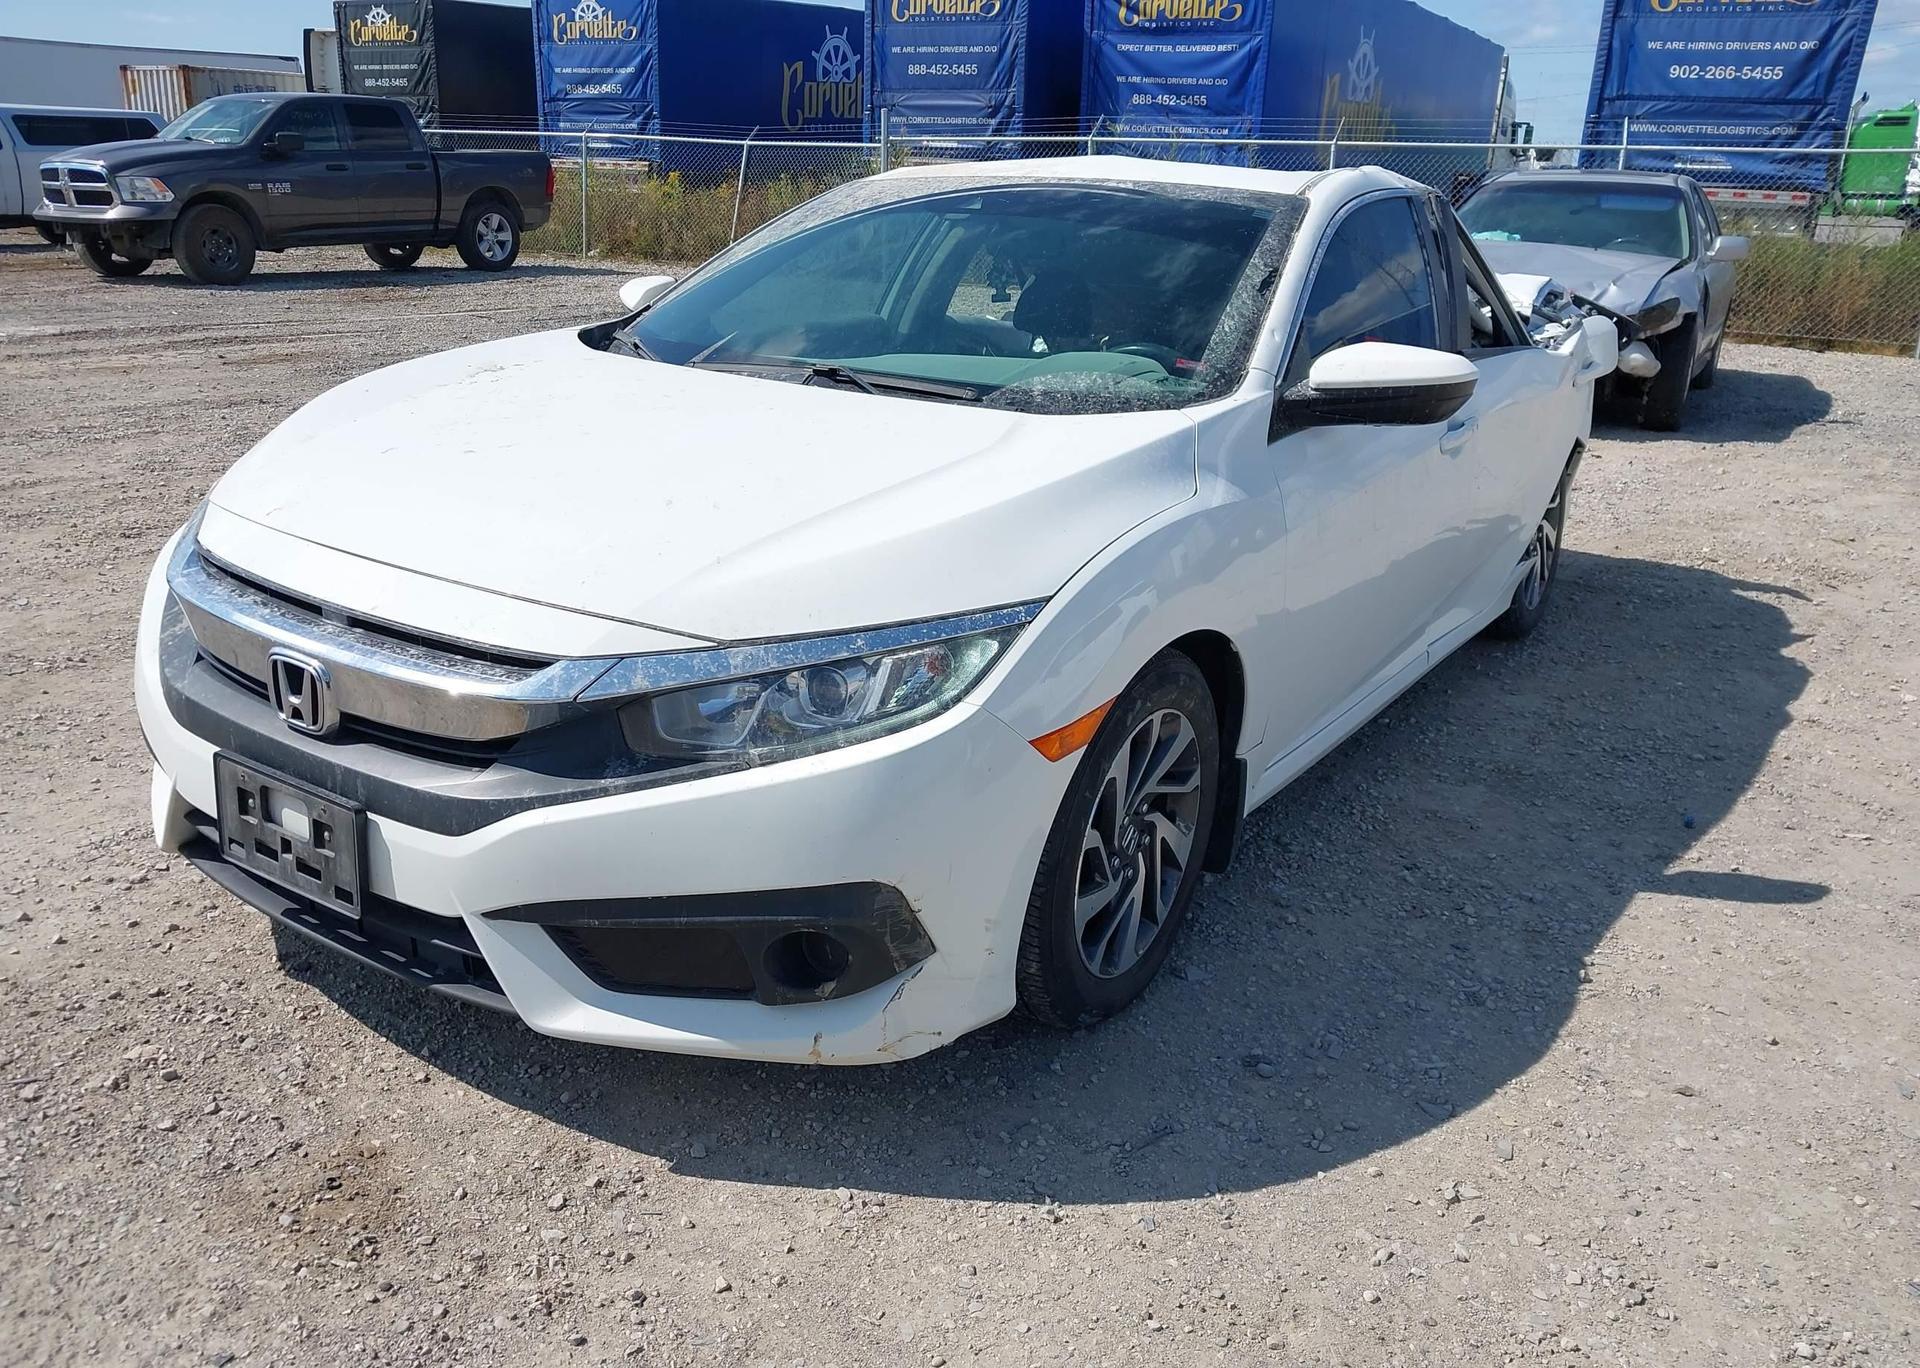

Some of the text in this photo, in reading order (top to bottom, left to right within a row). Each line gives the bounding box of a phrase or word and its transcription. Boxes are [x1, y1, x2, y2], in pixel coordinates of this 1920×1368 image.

[350, 16, 416, 46] Corvette
[553, 9, 637, 45] Corvette
[1144, 44, 1174, 52] BETTER,
[1175, 44, 1216, 52] DELIVERED
[1647, 41, 1664, 49] WE
[1664, 41, 1686, 49] ARE
[1688, 42, 1724, 50] HIRING
[1725, 42, 1771, 50] DRIVERS
[1773, 42, 1797, 50] AND
[908, 64, 978, 75] 888-452-5455
[1669, 65, 1784, 79] 902-266-5455
[364, 78, 408, 87] 888-452-5455
[1166, 77, 1197, 85] DRIVERS
[566, 84, 623, 94] 888-452-5455
[782, 61, 864, 131] Corvet
[1132, 94, 1207, 106] 888-452-5455
[1630, 123, 1797, 136] WWW.CORVETTELOGISTICS.COM
